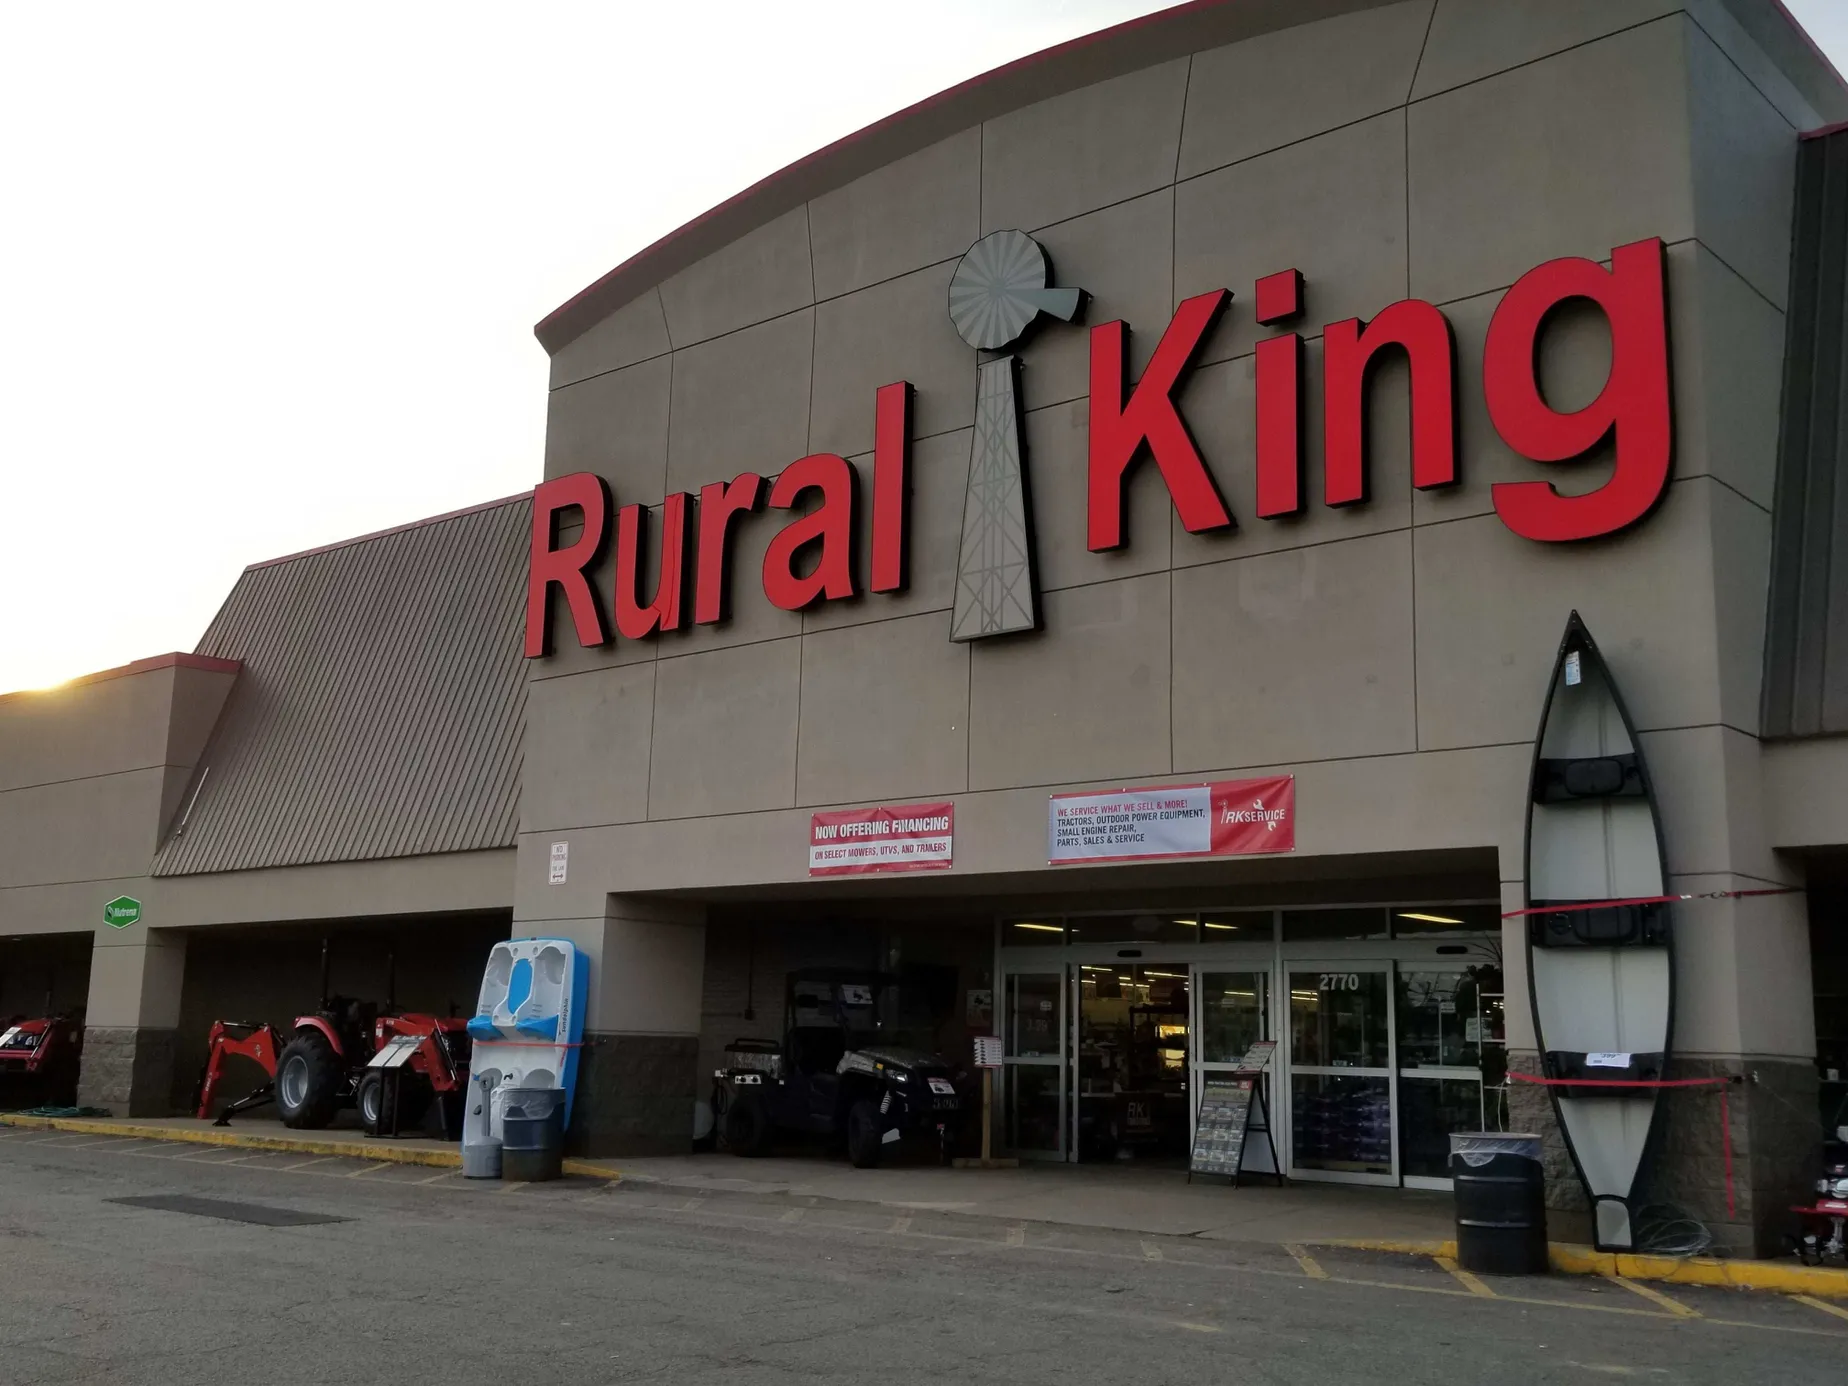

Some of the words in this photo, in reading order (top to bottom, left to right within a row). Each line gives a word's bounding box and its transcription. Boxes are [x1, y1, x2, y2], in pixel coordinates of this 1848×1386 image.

[524, 381, 911, 659] Rural
[1087, 236, 1671, 553] King
[1057, 808, 1068, 817] WE
[1070, 806, 1099, 816] SERVICE
[1101, 804, 1121, 814] WHAT
[1123, 803, 1136, 812] WE
[1136, 801, 1155, 811] SELL
[1156, 801, 1163, 810] &
[1164, 799, 1188, 809] MORE!
[1057, 816, 1095, 827] TRACTORS,
[1096, 813, 1130, 825] OUTDOOR
[1131, 812, 1158, 823] POWER
[1159, 808, 1206, 821] EQUIPMENT,
[815, 824, 838, 840] NOW
[840, 819, 890, 838] OFFERING
[892, 816, 949, 834] FINANCING
[1057, 827, 1080, 838] SMALL
[1081, 825, 1107, 836] ENGINE
[1109, 823, 1137, 834] REPAIR,
[1057, 837, 1082, 847] PARTS,
[1083, 835, 1105, 846] SALES
[1106, 834, 1113, 844] &
[1115, 833, 1145, 844] SERVICE
[815, 850, 824, 860] ON
[824, 848, 847, 860] SELECT
[848, 847, 878, 858] MOWERS,
[901, 844, 914, 854] AND
[1319, 973, 1360, 991] 2770
